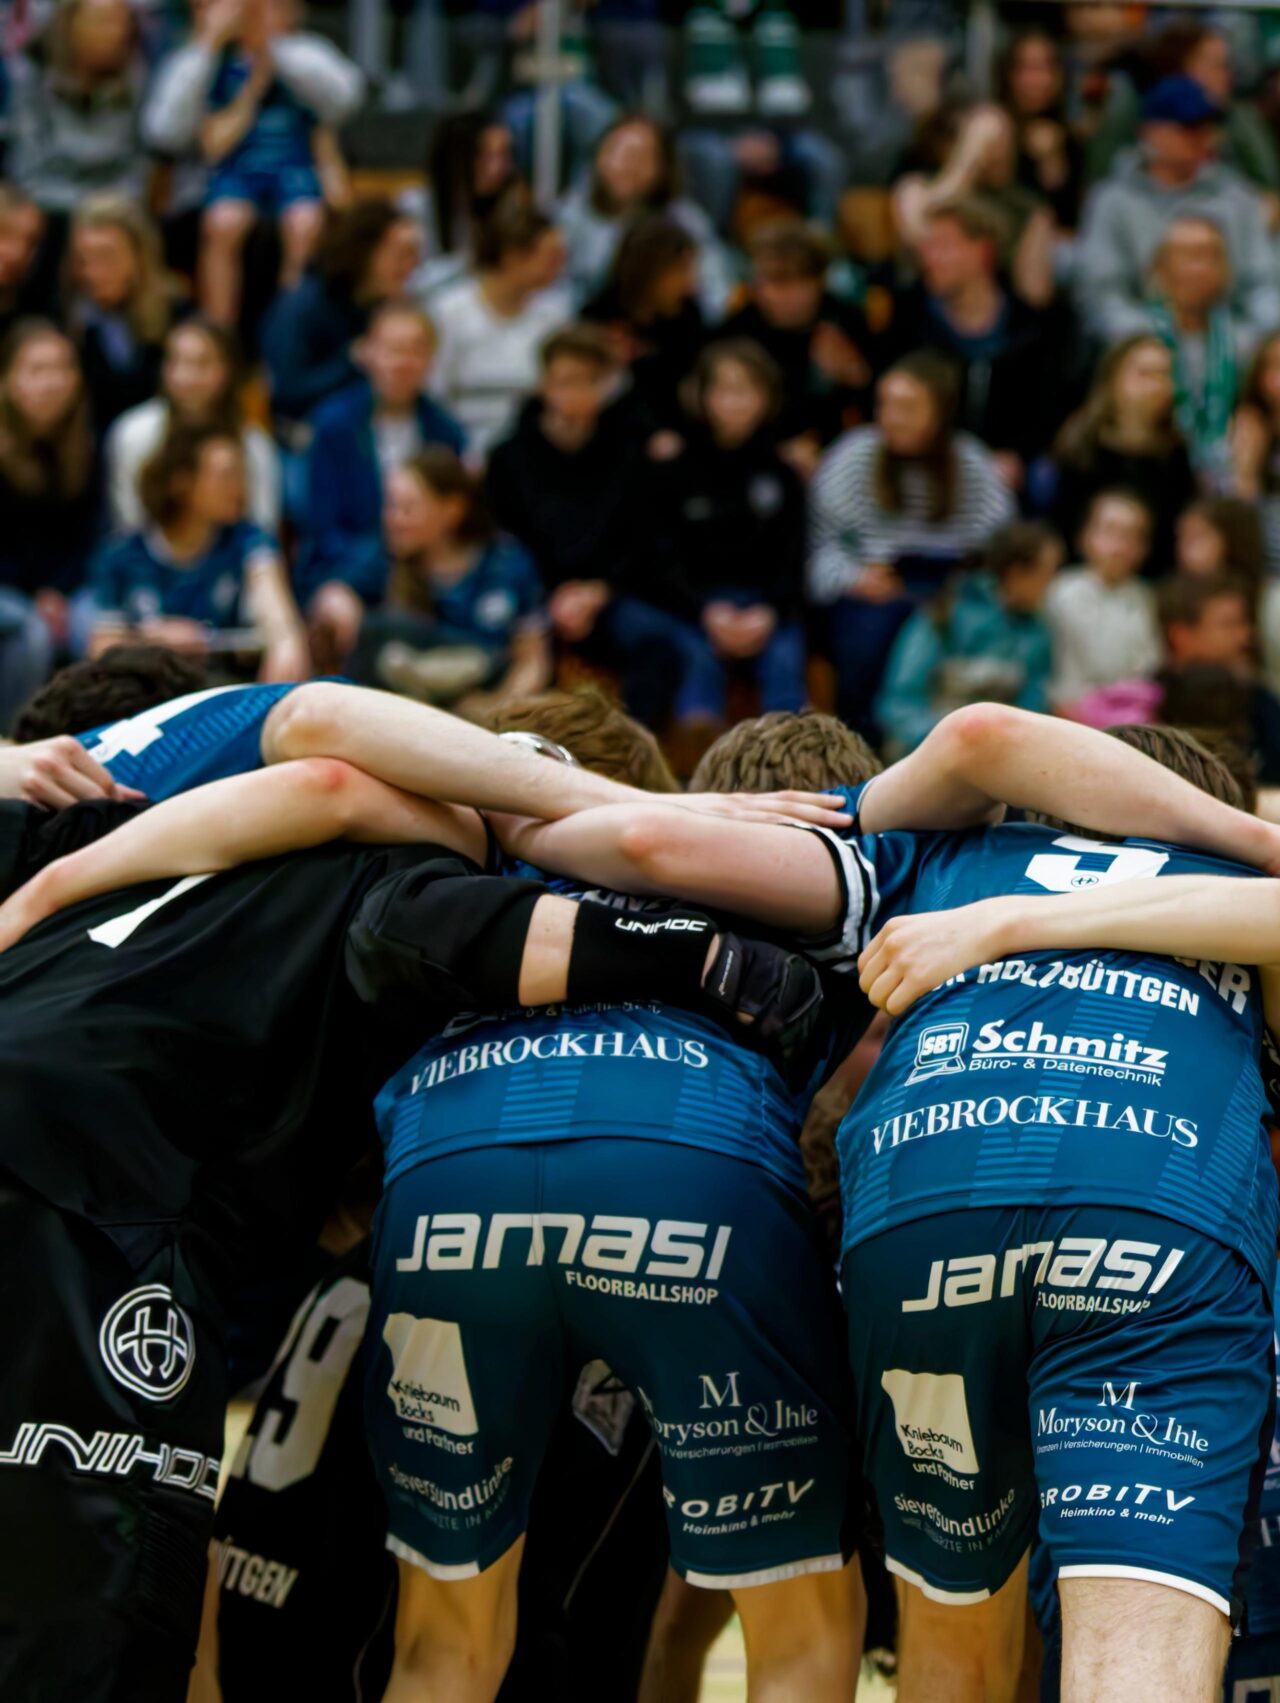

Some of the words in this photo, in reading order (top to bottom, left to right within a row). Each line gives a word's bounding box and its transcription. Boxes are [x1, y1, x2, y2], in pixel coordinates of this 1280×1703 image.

[614, 917, 708, 935] UNIHOC
[921, 1032, 962, 1057] SBT
[972, 1019, 1169, 1068] Schmitz
[411, 1032, 709, 1095] VIEBROCKHAUS
[968, 1057, 1017, 1072] Büro-
[1023, 1058, 1036, 1069] &
[1042, 1060, 1162, 1087] Datentechnik
[871, 1095, 1199, 1156] VIEBROCKHAUS
[565, 1269, 719, 1305] FLOORBALLSHOP
[698, 1371, 742, 1409] M
[1097, 1381, 1142, 1411] M
[646, 1402, 740, 1446] oryson
[744, 1402, 779, 1437] &
[774, 1399, 818, 1431] Ihle
[1037, 1407, 1126, 1437] Moryson
[1131, 1414, 1166, 1445] &
[1162, 1416, 1209, 1452] Ihle
[402, 1426, 425, 1444] und
[426, 1427, 475, 1455] Partner
[900, 1424, 963, 1453] Kniebaum
[907, 1440, 944, 1460] Bocks
[912, 1462, 937, 1476] und
[1064, 1440, 1137, 1453] Versicherungen
[1146, 1445, 1204, 1469] Immobilien
[1060, 1506, 1115, 1519] Heimkino
[1120, 1508, 1131, 1518] &
[1134, 1511, 1175, 1526] mehr
